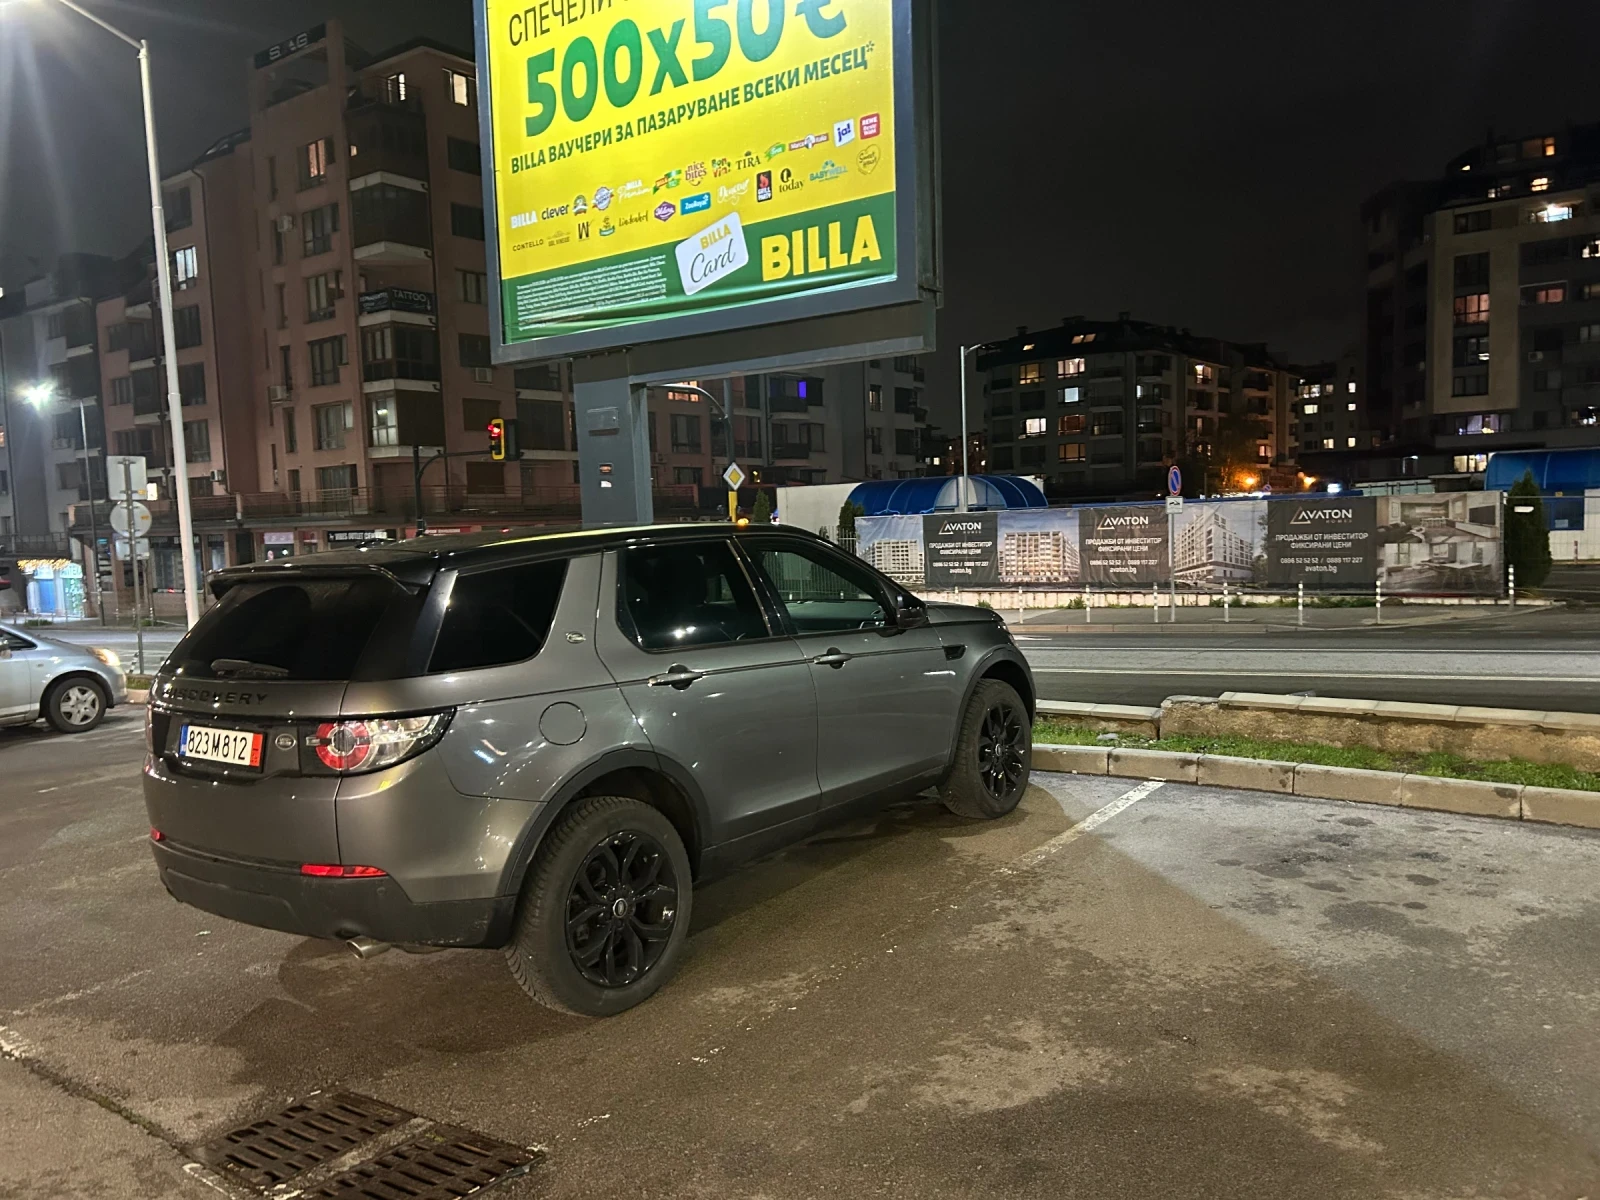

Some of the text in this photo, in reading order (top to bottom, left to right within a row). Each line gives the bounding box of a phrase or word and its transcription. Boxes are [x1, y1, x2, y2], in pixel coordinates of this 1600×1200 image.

[511, 149, 546, 174] BILLA
[548, 127, 613, 163] ВАУЧЕРИ
[615, 121, 635, 143] ЗА
[637, 86, 740, 136] ПАЗАРУВАНЕ
[743, 67, 800, 103] ВСЕКИ
[837, 123, 851, 142] ja!
[688, 161, 705, 172] nice
[736, 155, 761, 170] TIRA
[685, 168, 707, 181] bites
[809, 165, 848, 182] BABYWELL
[779, 178, 804, 193] today
[541, 204, 570, 220] clever
[511, 210, 538, 229] BILLA
[700, 223, 732, 250] BILLA
[512, 239, 544, 252] CONTELLO
[761, 214, 882, 282] BILLA
[690, 238, 736, 283] Card
[392, 289, 427, 302] TATTOO
[1298, 508, 1353, 519] AVATON
[944, 522, 982, 531] AVATON
[1104, 516, 1149, 526] AVATON
[1275, 534, 1313, 542] ПРОДАЖБИ
[1323, 532, 1369, 540] ИНВЕСТИТОР
[1333, 541, 1352, 549] ЦЕНИ
[1304, 565, 1338, 573] avaton.bg
